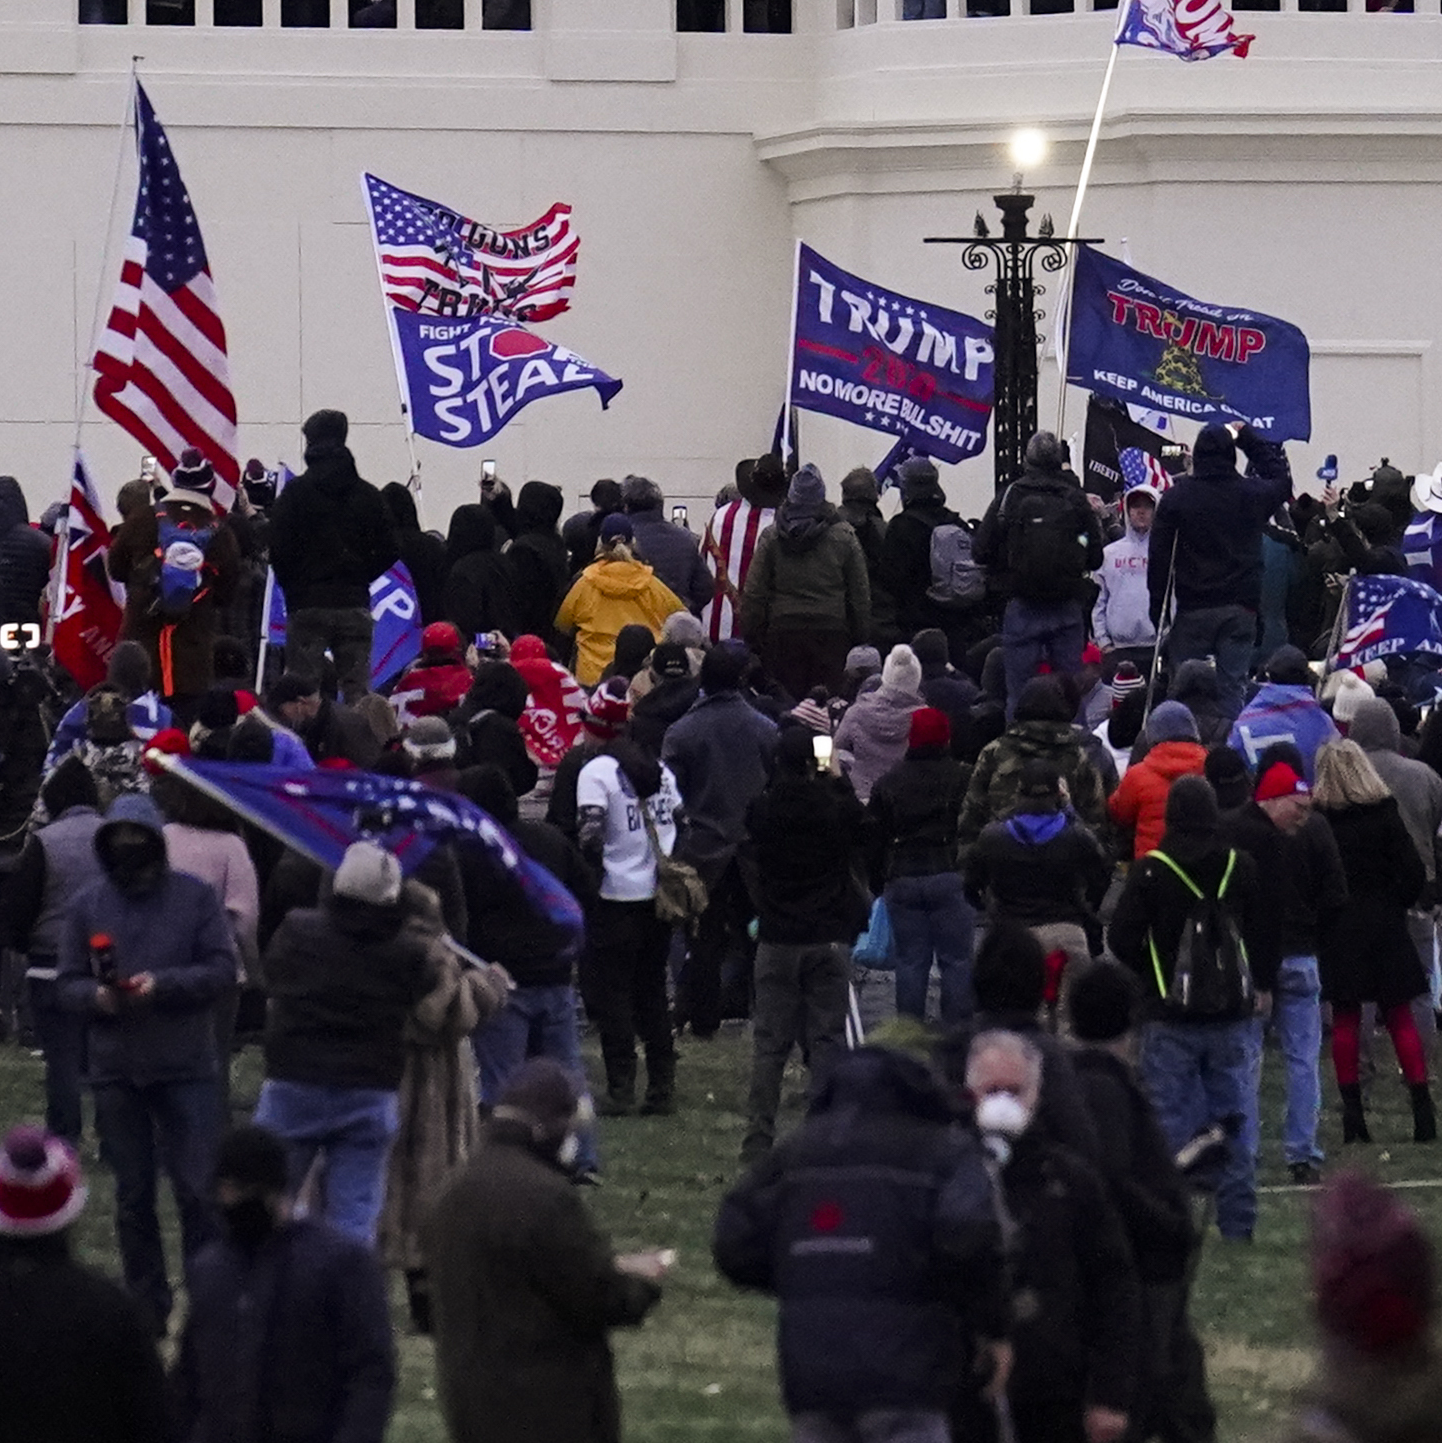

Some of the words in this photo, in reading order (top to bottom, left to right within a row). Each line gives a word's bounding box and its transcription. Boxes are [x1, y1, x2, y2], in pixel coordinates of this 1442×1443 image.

[463, 221, 553, 260] GUNS
[419, 322, 471, 340] FIGHT
[810, 269, 996, 382] TRUMP
[1108, 291, 1266, 364] TRUMP
[434, 358, 595, 442] STEAL
[799, 369, 833, 395] NO
[835, 378, 900, 416] MORE
[1093, 369, 1138, 391] KEEP
[1141, 385, 1217, 414] AMERICA
[1350, 637, 1406, 668] KEEP
